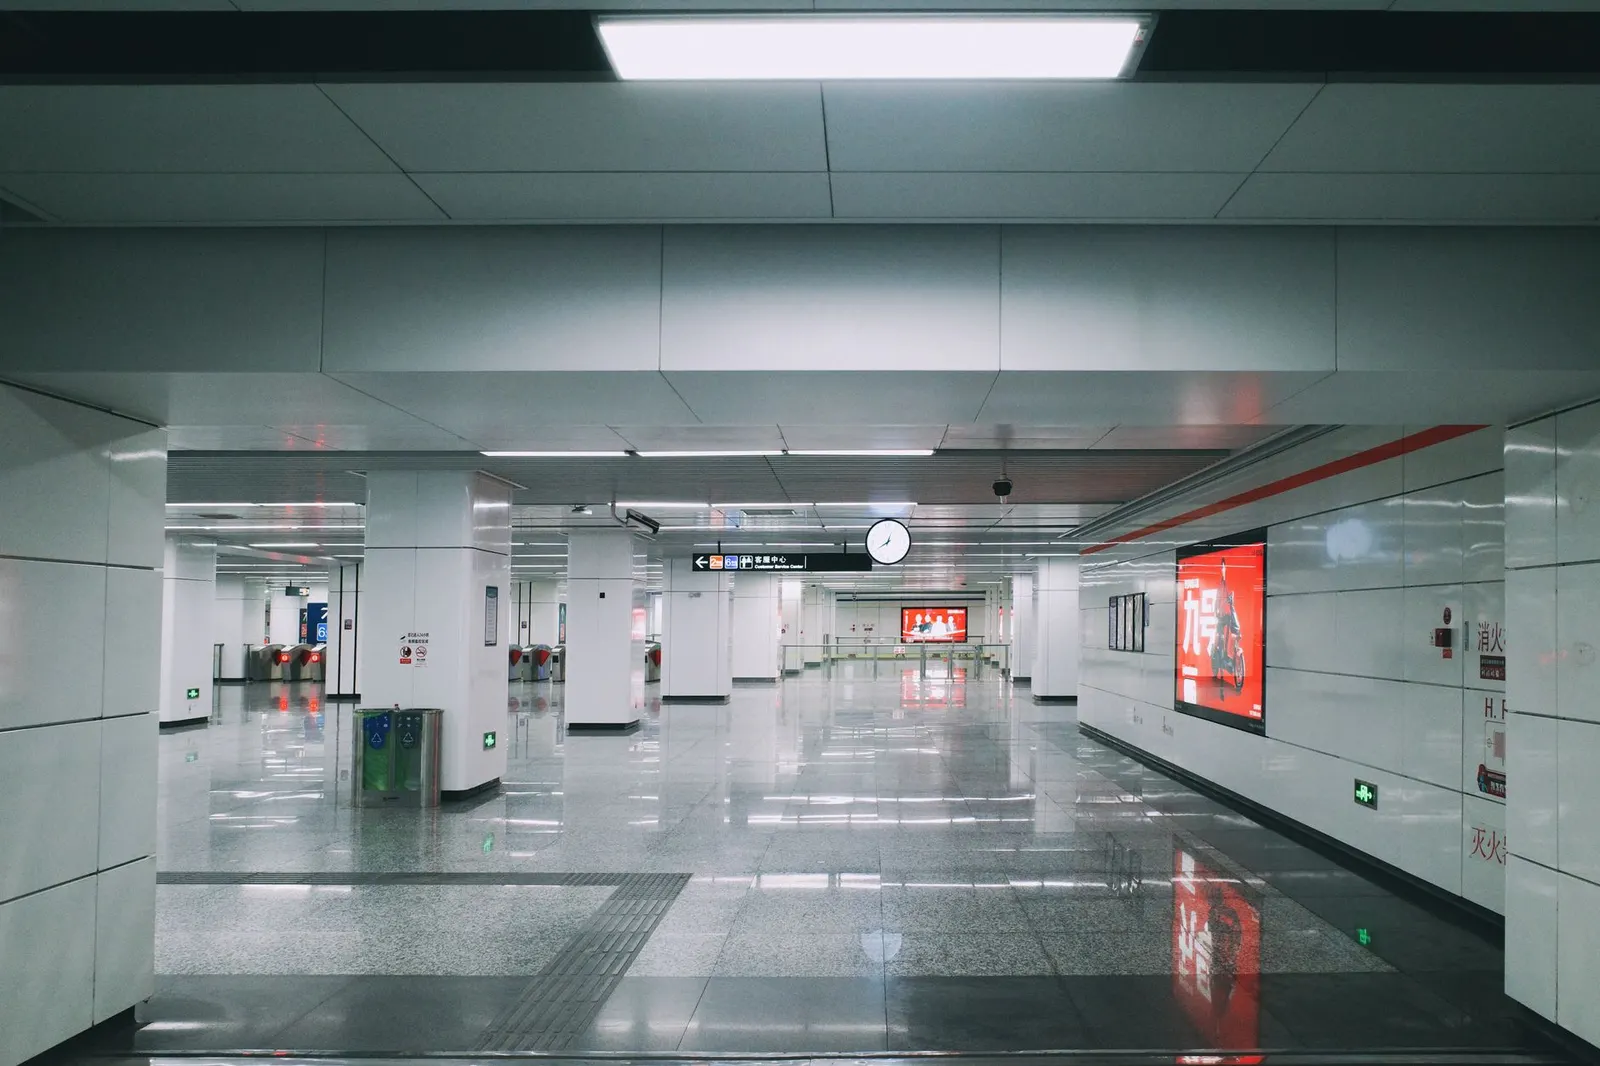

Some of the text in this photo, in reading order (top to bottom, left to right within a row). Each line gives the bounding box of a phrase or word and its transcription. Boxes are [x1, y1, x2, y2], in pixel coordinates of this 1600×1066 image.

[754, 555, 787, 564] 客服中心
[1182, 588, 1218, 657] 九号
[1478, 620, 1506, 653] 消火
[1470, 824, 1506, 865] 灭火
